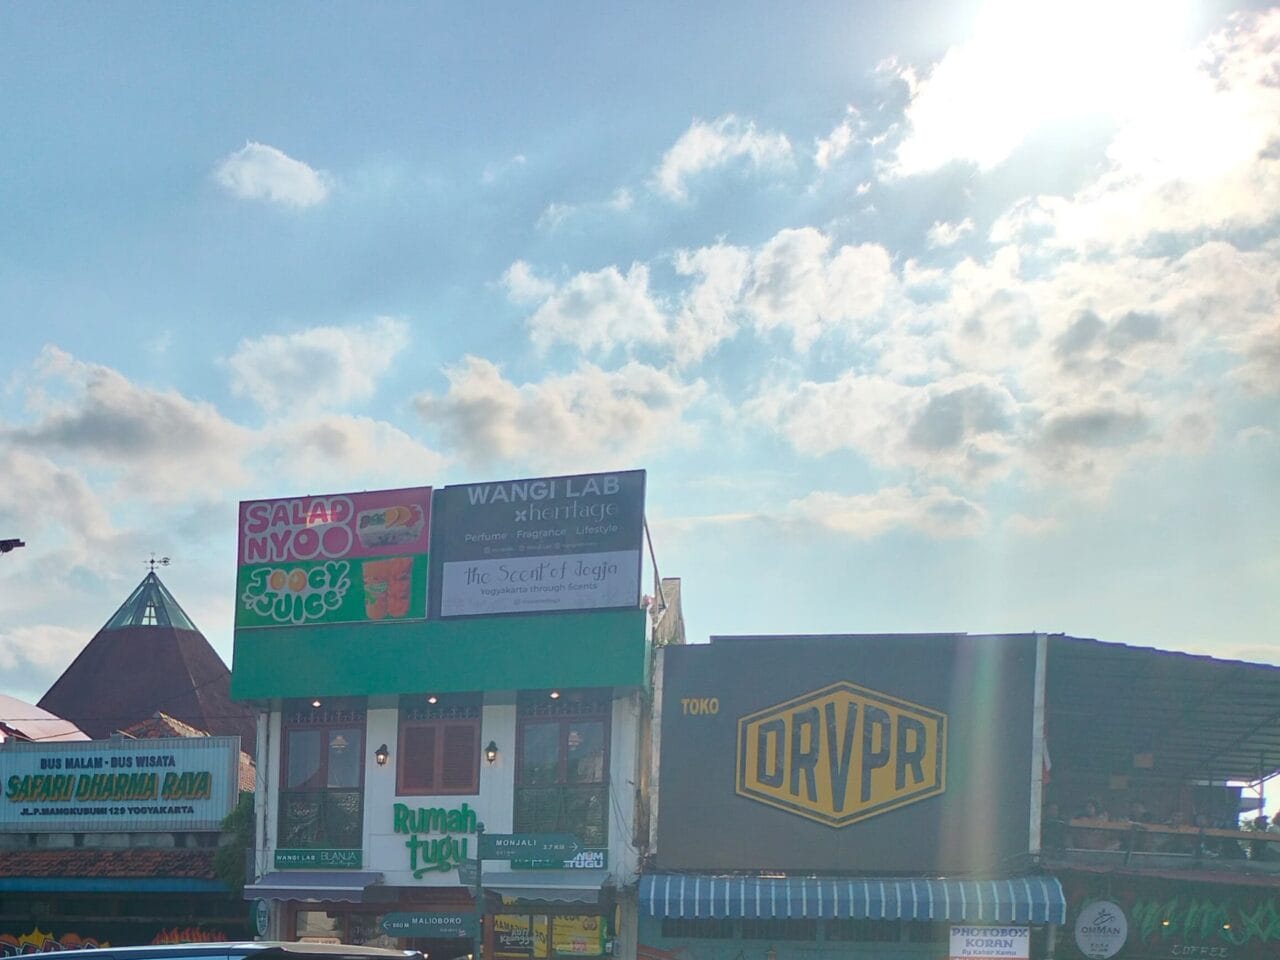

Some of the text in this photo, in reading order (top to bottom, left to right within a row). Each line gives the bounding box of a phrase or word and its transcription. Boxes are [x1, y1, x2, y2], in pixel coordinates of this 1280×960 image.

[468, 475, 620, 505] WANGI LAB
[245, 497, 354, 534] SALAD
[464, 523, 618, 544] Perfume Fragrance Lifestyle
[244, 526, 353, 563] NYOO
[464, 566, 490, 586] the
[549, 561, 567, 580] of
[574, 560, 618, 582] Jogja
[480, 582, 599, 597] Yogyakarta through Scents
[681, 697, 719, 716] TOKO
[40, 757, 62, 770] BUS
[65, 757, 104, 769] MALAM
[110, 757, 133, 769] BUS
[135, 755, 176, 768] WISATA
[755, 700, 927, 813] DRVPR
[5, 771, 214, 803] SAFARI DHARMA RAYA
[108, 806, 126, 815] 129
[127, 805, 195, 815] YOGYAKARTA
[393, 803, 477, 834] Rumah
[406, 835, 468, 879] tugu
[411, 917, 462, 925] MALIOBORO
[951, 926, 1028, 938] PHOTOBOX
[965, 938, 1014, 949] KORAN
[1171, 944, 1229, 958] COFFEE
